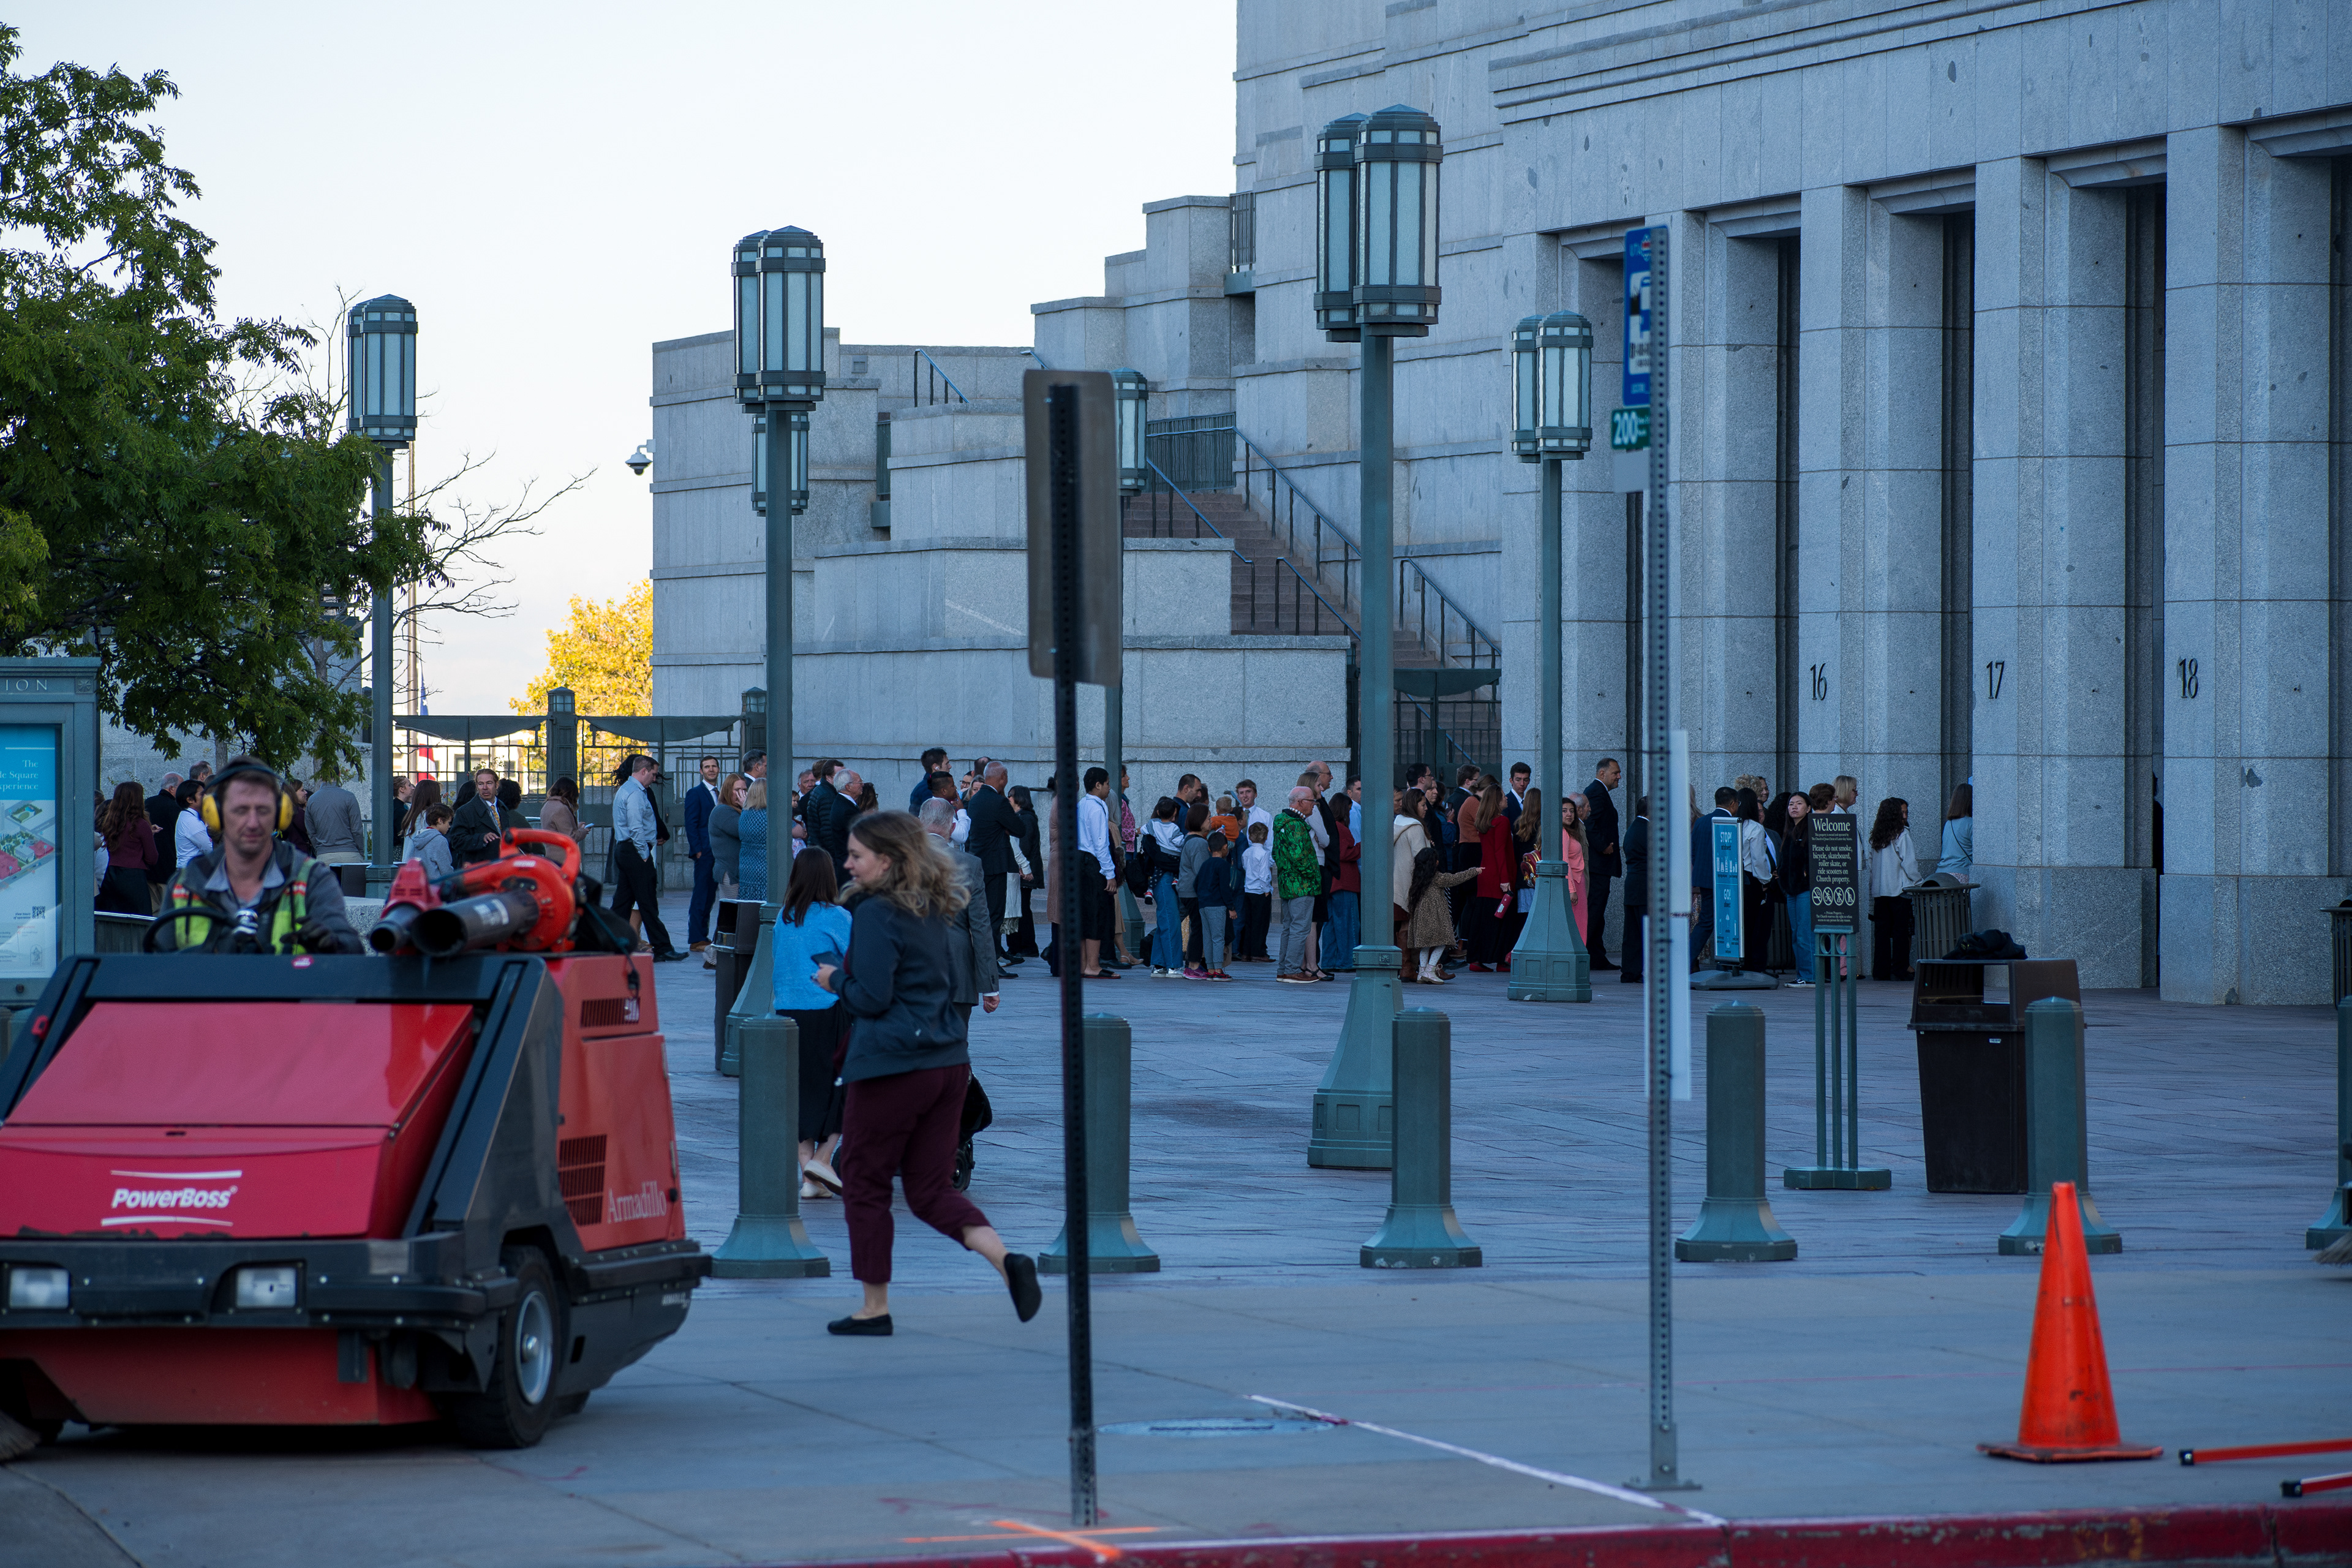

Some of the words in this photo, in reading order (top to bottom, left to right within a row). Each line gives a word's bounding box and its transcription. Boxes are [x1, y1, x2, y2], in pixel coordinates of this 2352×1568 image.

[1613, 410, 1638, 445] 200
[6, 679, 47, 692] ION
[1810, 663, 1828, 701] 16
[1986, 660, 2005, 699] 17
[2179, 658, 2199, 699] 18
[22, 760, 39, 768] The
[9, 771, 39, 781] Square
[1812, 818, 1850, 831] Welcome
[1720, 832, 1732, 843] STOP!
[1813, 852, 1827, 861] bicycle,
[111, 1187, 232, 1208] PowerBoss
[607, 1180, 667, 1224] Armadillo
